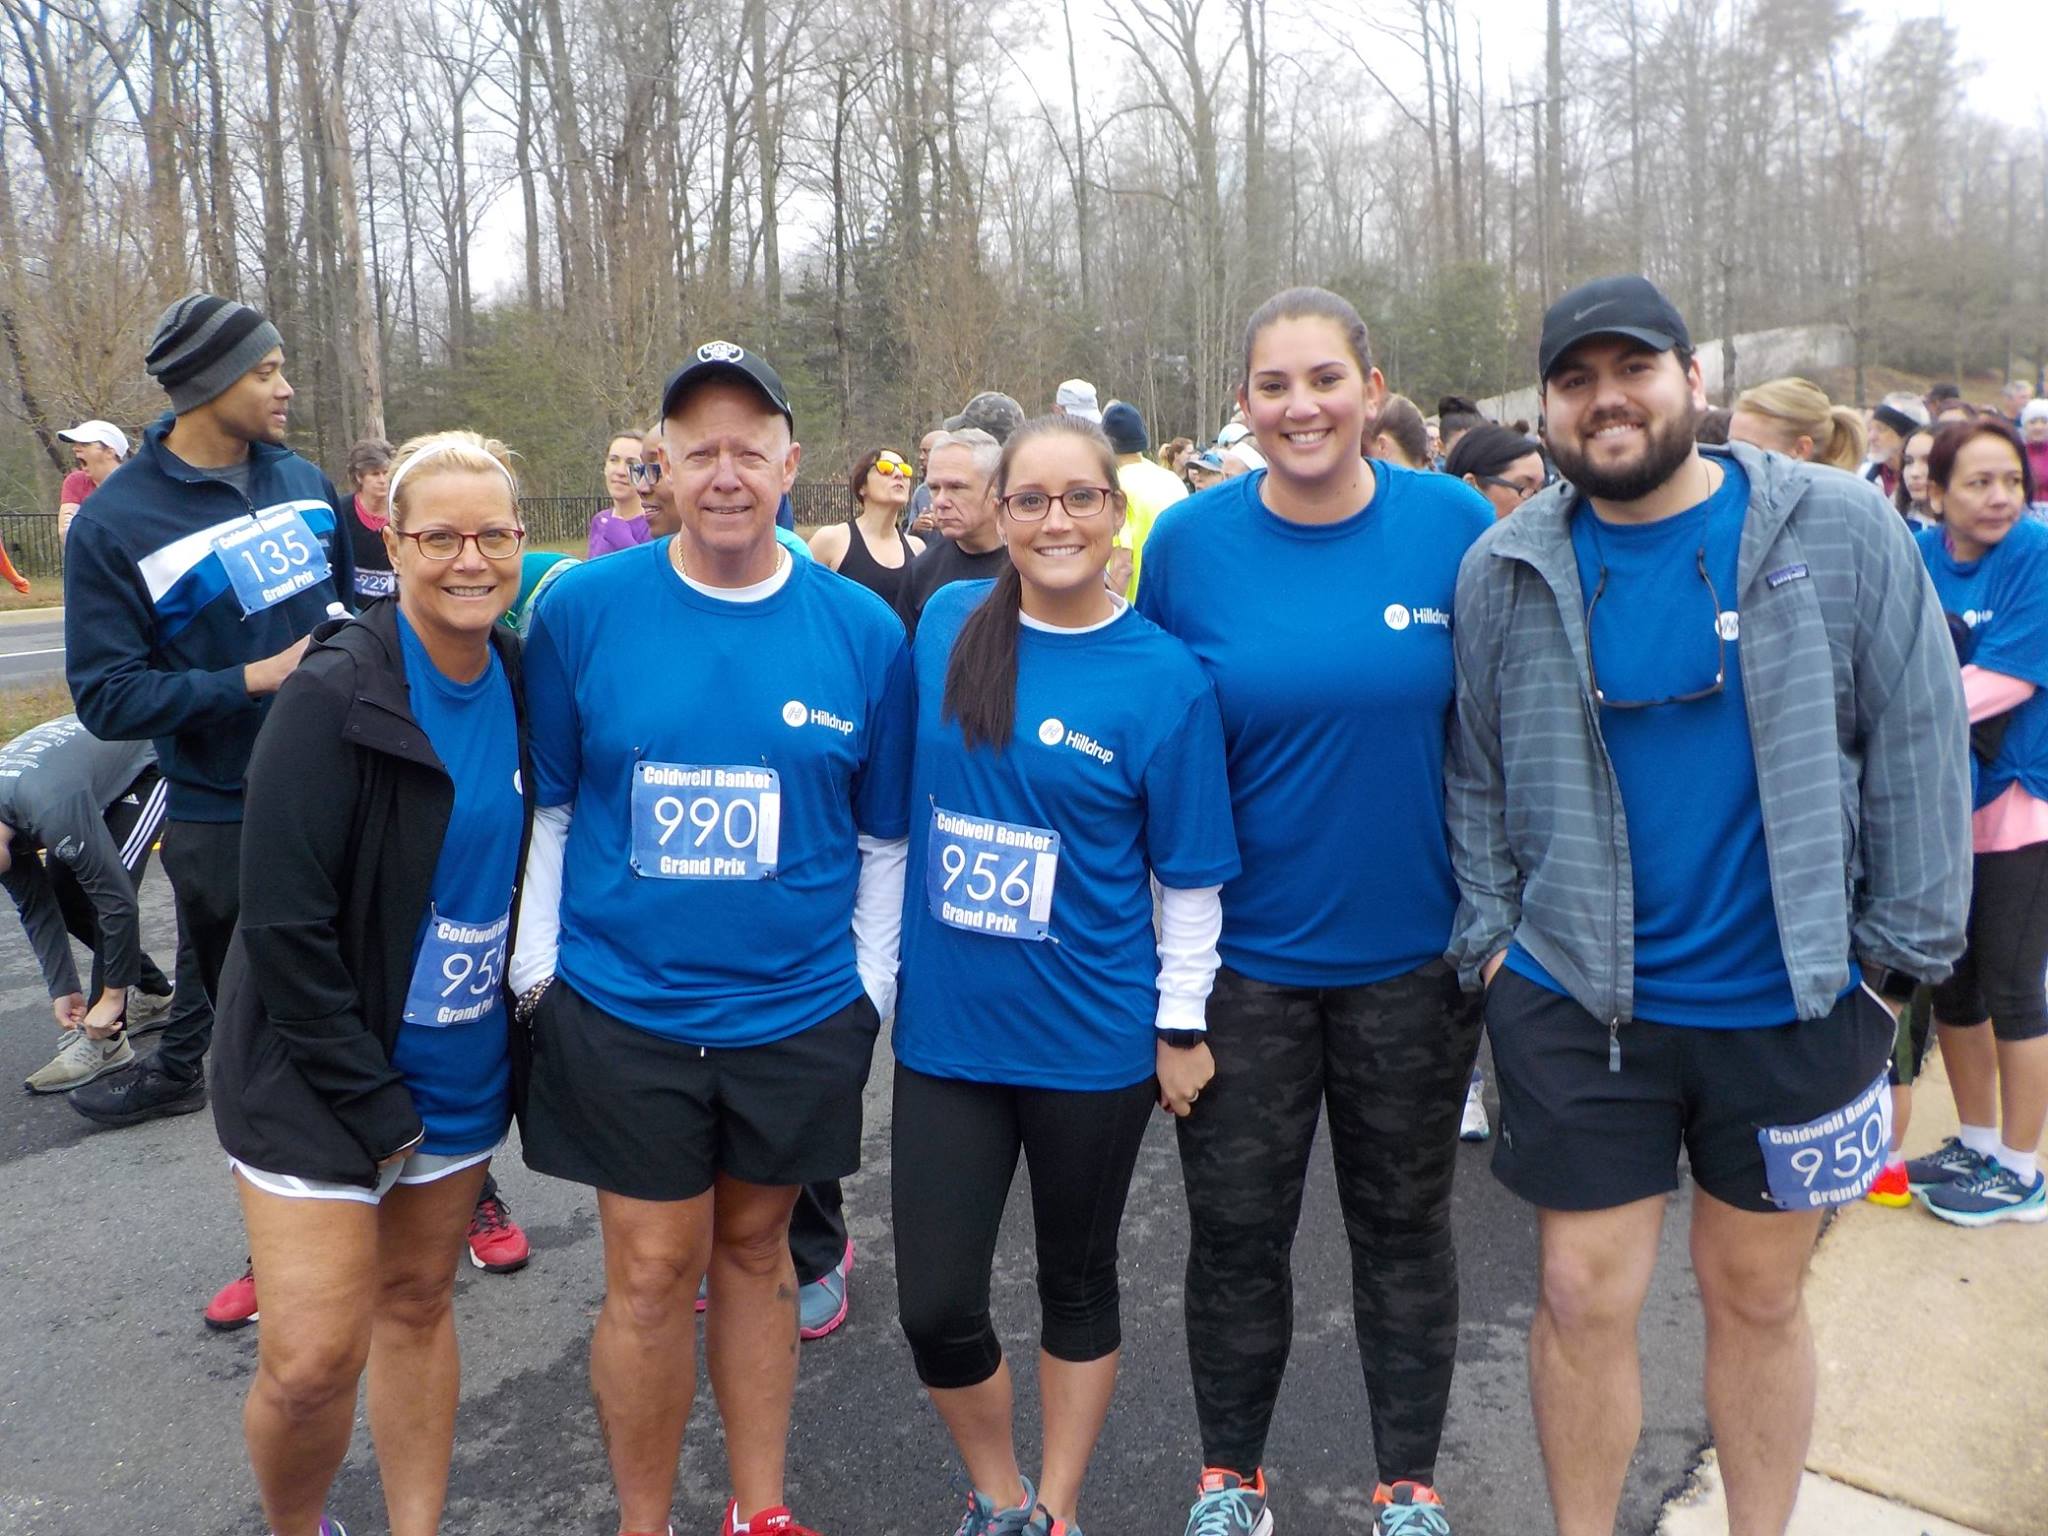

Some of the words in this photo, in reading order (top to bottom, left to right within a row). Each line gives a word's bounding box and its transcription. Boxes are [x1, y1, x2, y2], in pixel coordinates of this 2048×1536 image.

[241, 530, 309, 583] 135
[262, 578, 297, 603] Grand
[360, 574, 389, 590] 929
[810, 708, 854, 736] Hilldrup
[1065, 730, 1114, 765] Hilldrup
[643, 766, 712, 787] Coldwell
[715, 769, 771, 789] Banker
[654, 796, 757, 849] 990
[937, 812, 995, 842] Coldwell
[995, 825, 1052, 852] Banker
[660, 855, 710, 875] Grand
[713, 857, 746, 876] Prix
[942, 844, 1030, 907] 956
[942, 901, 984, 928] Grand
[985, 911, 1018, 933] Prix
[437, 1002, 481, 1023] Grand
[1769, 1112, 1844, 1145] Coldwell
[1790, 1112, 1882, 1188] 950
[1808, 1179, 1862, 1206] Grand
